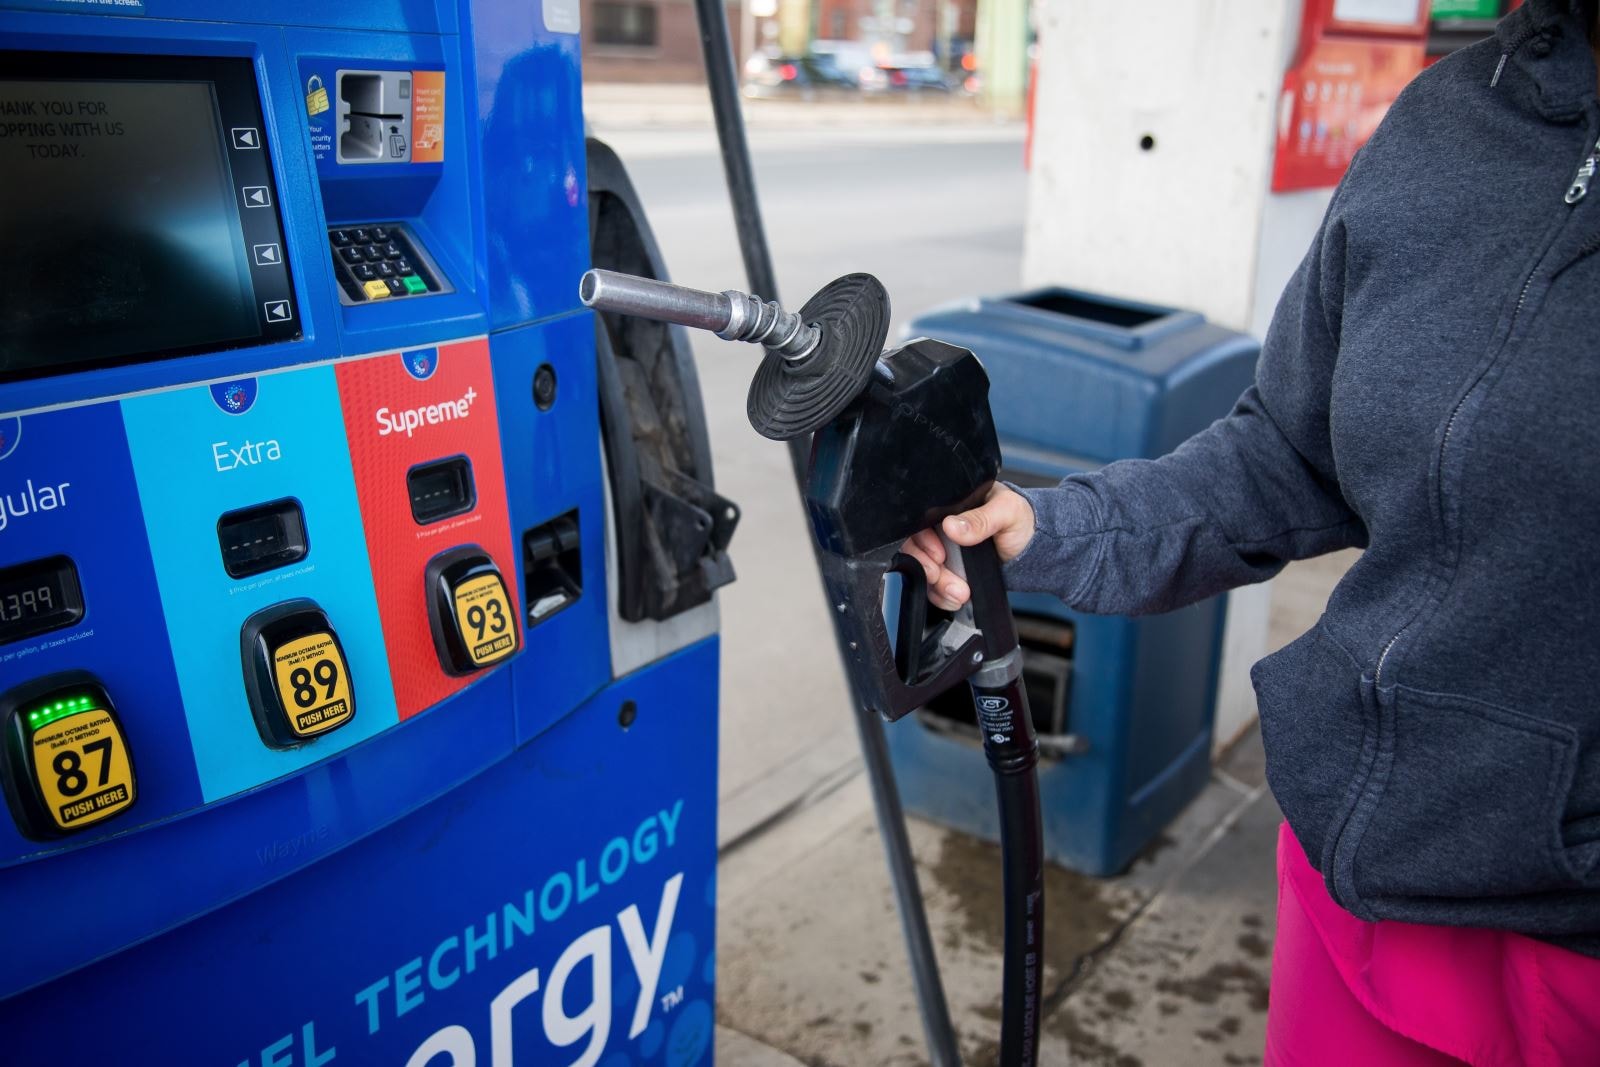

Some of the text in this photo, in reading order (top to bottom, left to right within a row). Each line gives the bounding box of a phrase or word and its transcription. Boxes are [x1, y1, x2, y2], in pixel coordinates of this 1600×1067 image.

[41, 101, 73, 116] YOU
[78, 101, 108, 114] FOR
[59, 122, 101, 136] WITH
[105, 122, 124, 136] US
[311, 134, 332, 142] ecurity
[26, 143, 86, 159] TODAY.
[212, 440, 281, 472] Extra
[295, 564, 315, 576] included
[467, 598, 506, 642] 93
[4, 652, 15, 662] per
[49, 639, 66, 647] taxes
[67, 628, 94, 642] included
[276, 640, 333, 663] MINIMUM OCTANE RATING
[306, 650, 325, 660] METHOD
[476, 636, 511, 658] PUSH HERE
[290, 659, 338, 708] 89
[300, 702, 346, 728] PUSH HERE
[35, 717, 111, 746] MINIMUM OCTANE RATING
[75, 729, 100, 741] METHOD
[52, 737, 112, 797] 87
[64, 788, 125, 820] PUSH HERE
[256, 823, 329, 867] Wayne
[236, 799, 684, 1067] EL TECHNOLOGY
[660, 985, 684, 1012] TM
